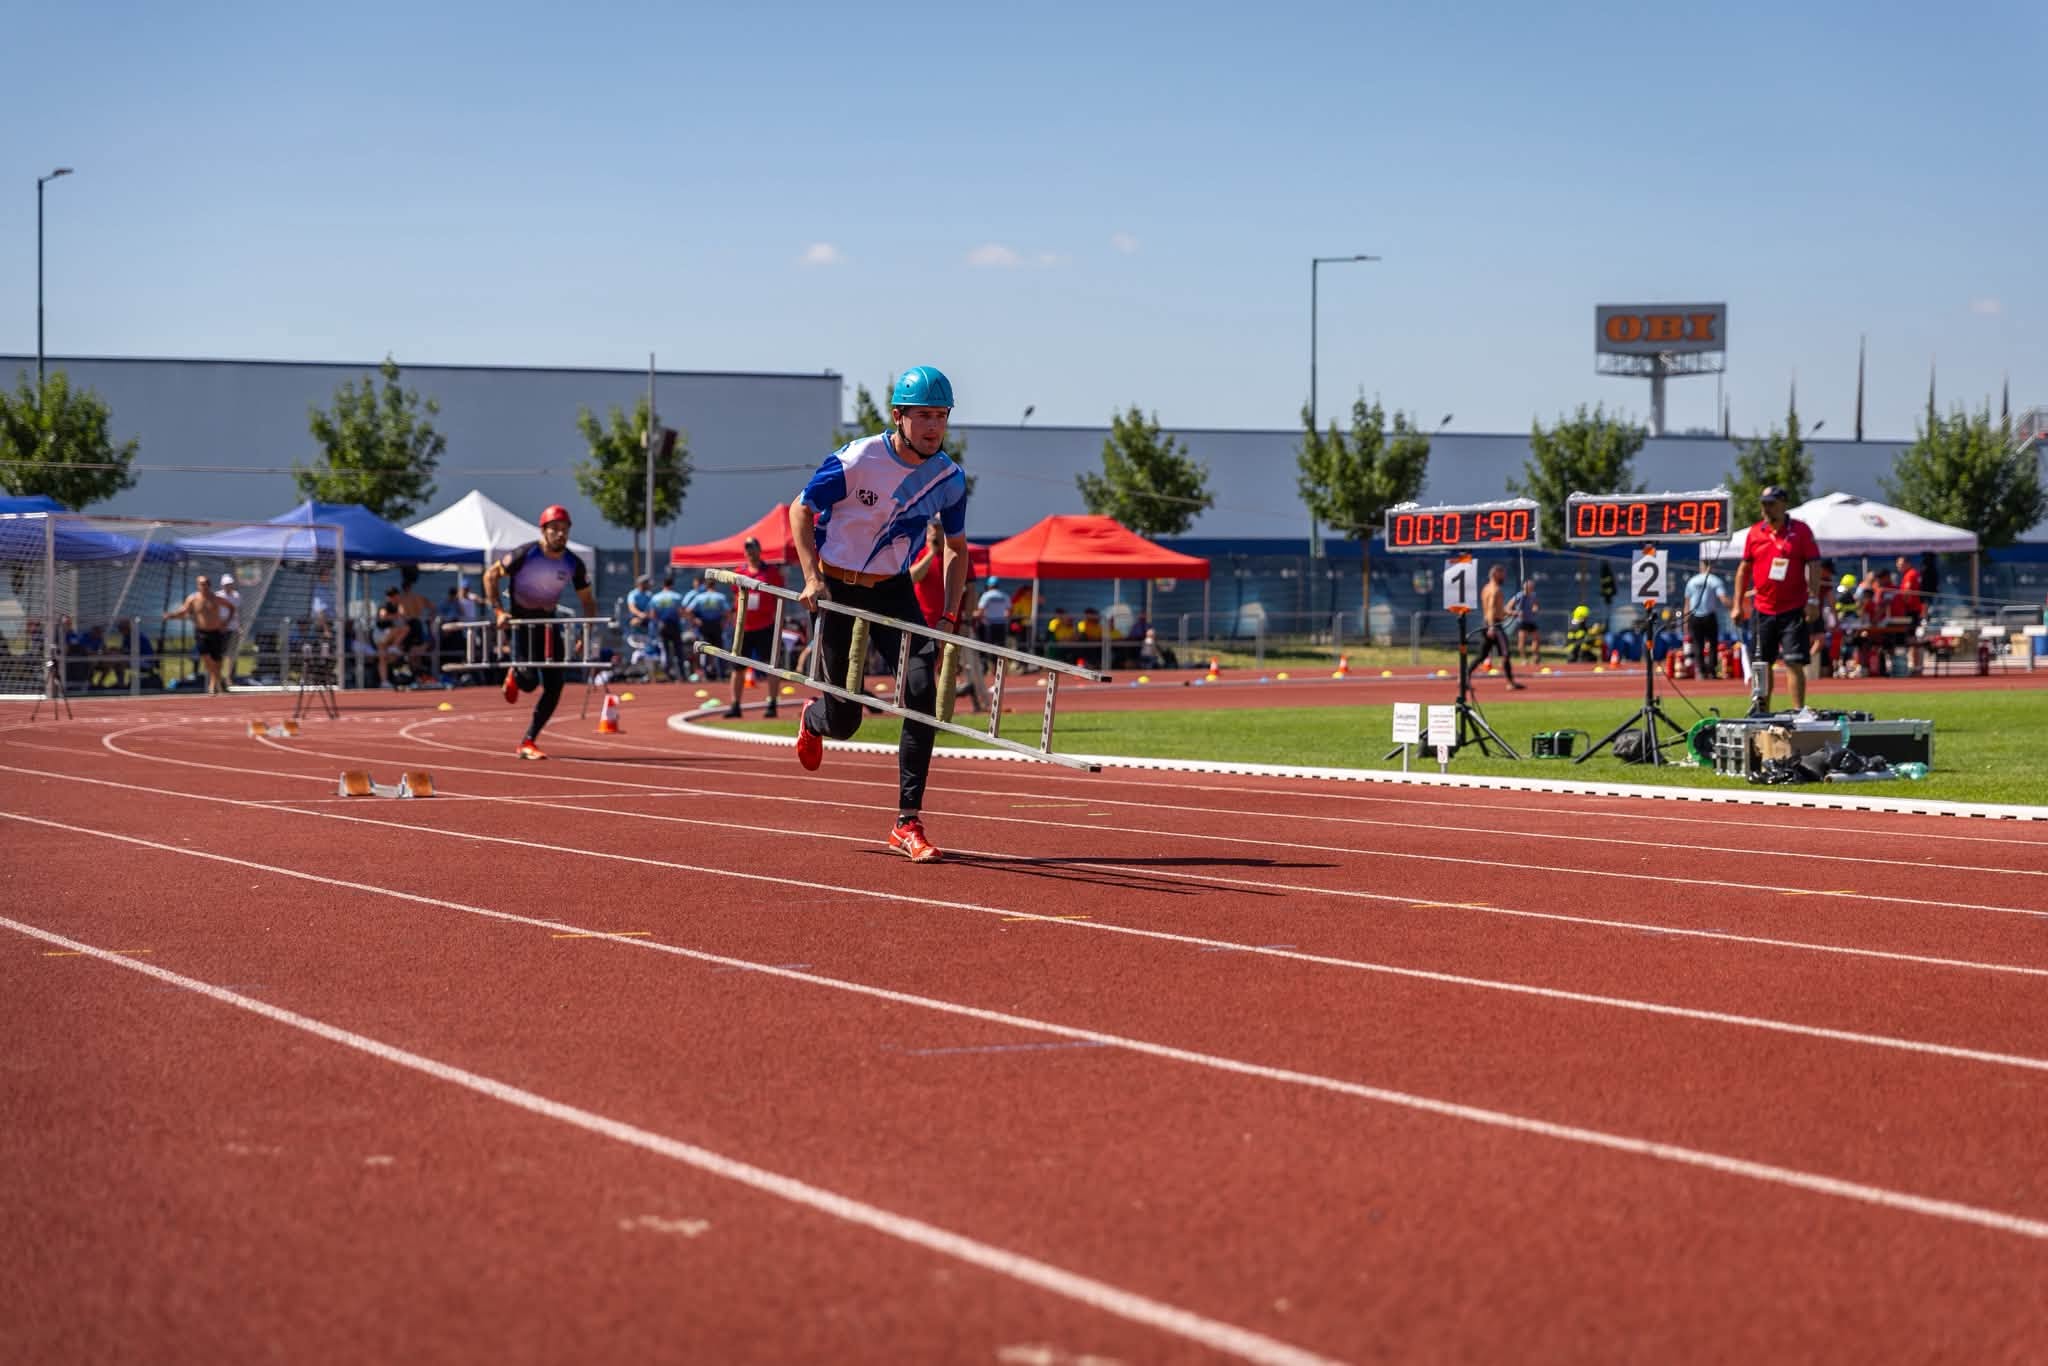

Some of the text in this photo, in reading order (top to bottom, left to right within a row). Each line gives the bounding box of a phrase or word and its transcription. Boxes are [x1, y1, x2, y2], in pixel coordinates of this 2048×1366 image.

[1606, 314, 1715, 343] OBI
[1395, 510, 1529, 545] 00:01:90
[1576, 501, 1721, 536] 00:01:90
[1451, 570, 1466, 603] 1
[1638, 562, 1660, 598] 2
